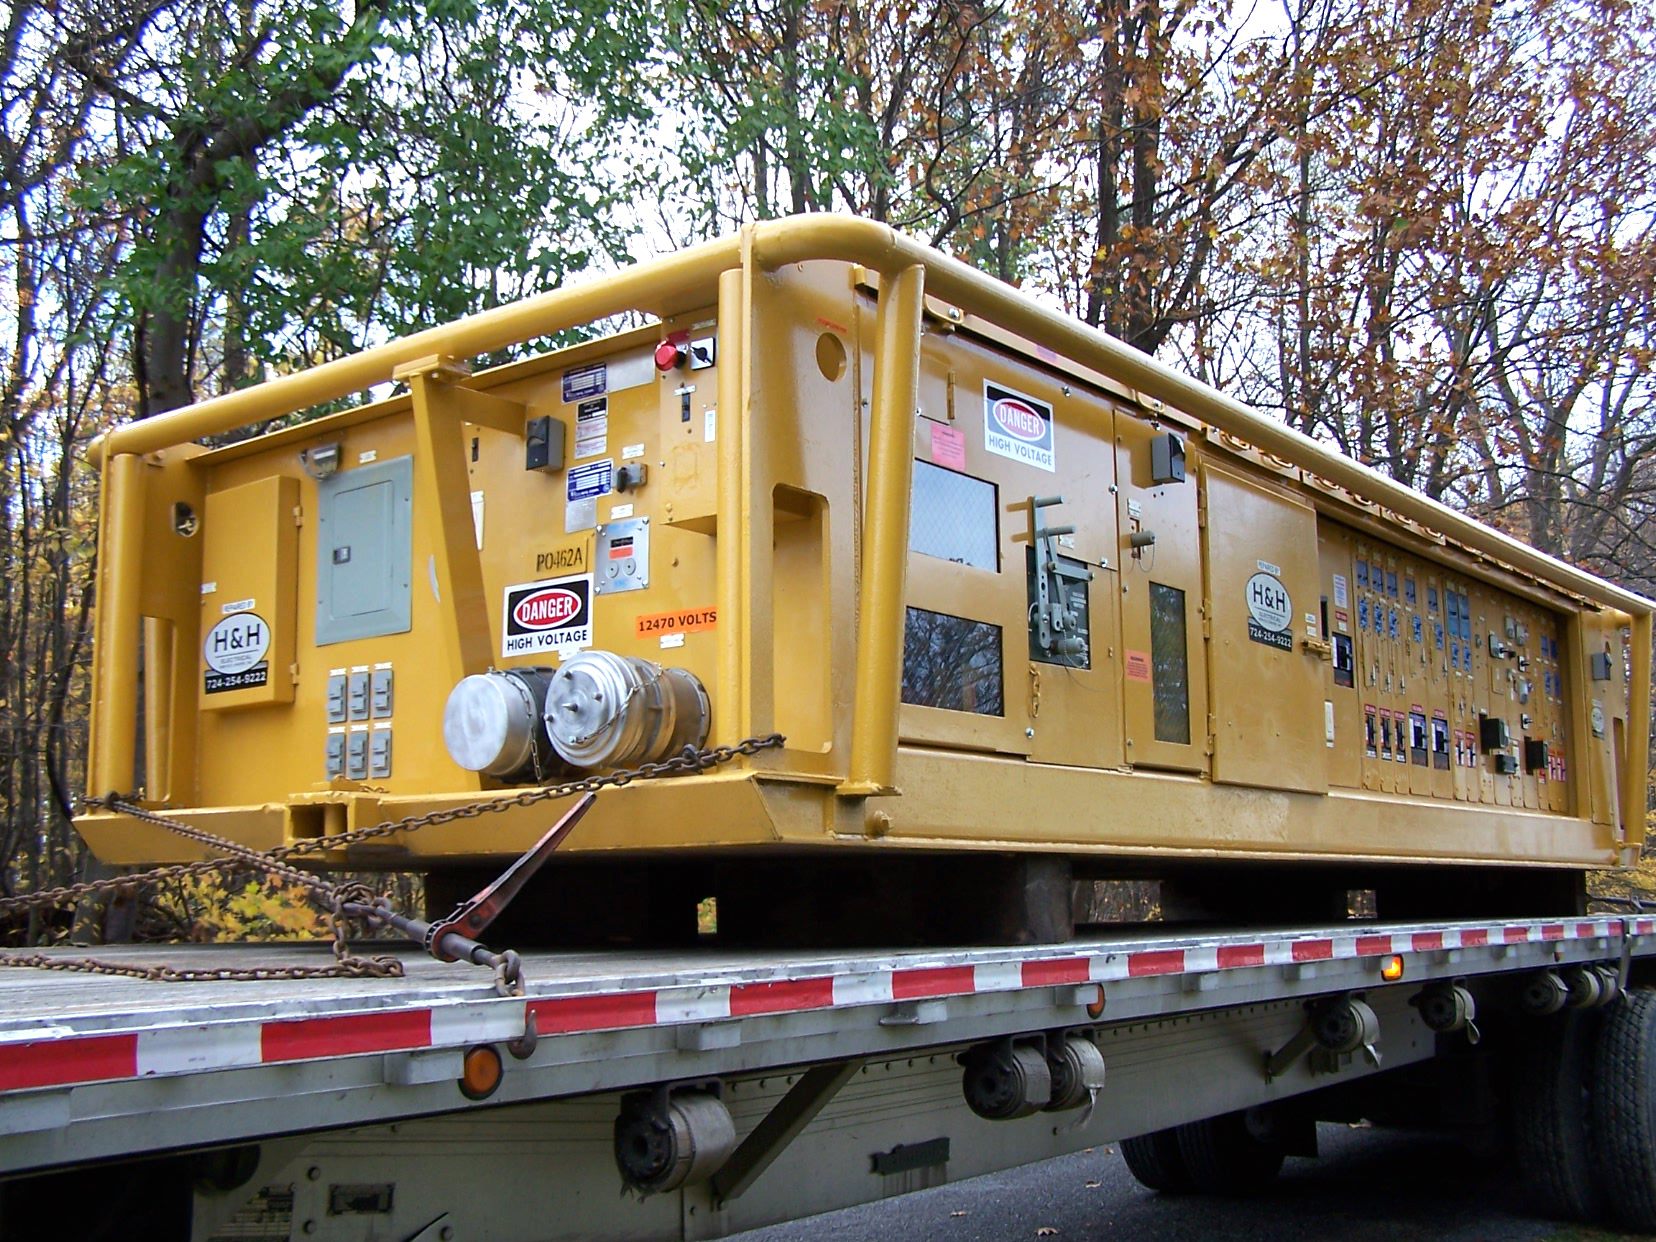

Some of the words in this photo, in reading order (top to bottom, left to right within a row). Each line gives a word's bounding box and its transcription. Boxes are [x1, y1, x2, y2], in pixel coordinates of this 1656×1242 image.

[1000, 403, 1040, 435] DANGER
[988, 435, 1011, 453] HIGH
[1014, 443, 1052, 466] VOLTAGE
[522, 596, 573, 622] DANGER
[1253, 582, 1286, 613] H&H
[639, 617, 675, 632] 12470
[679, 611, 717, 626] VOLTS
[214, 623, 260, 652] H&H
[507, 637, 533, 651] HIGH
[537, 630, 587, 646] VOLTAGE
[1250, 627, 1292, 648] 724-254-9222
[207, 671, 267, 689] 724-254-9222
